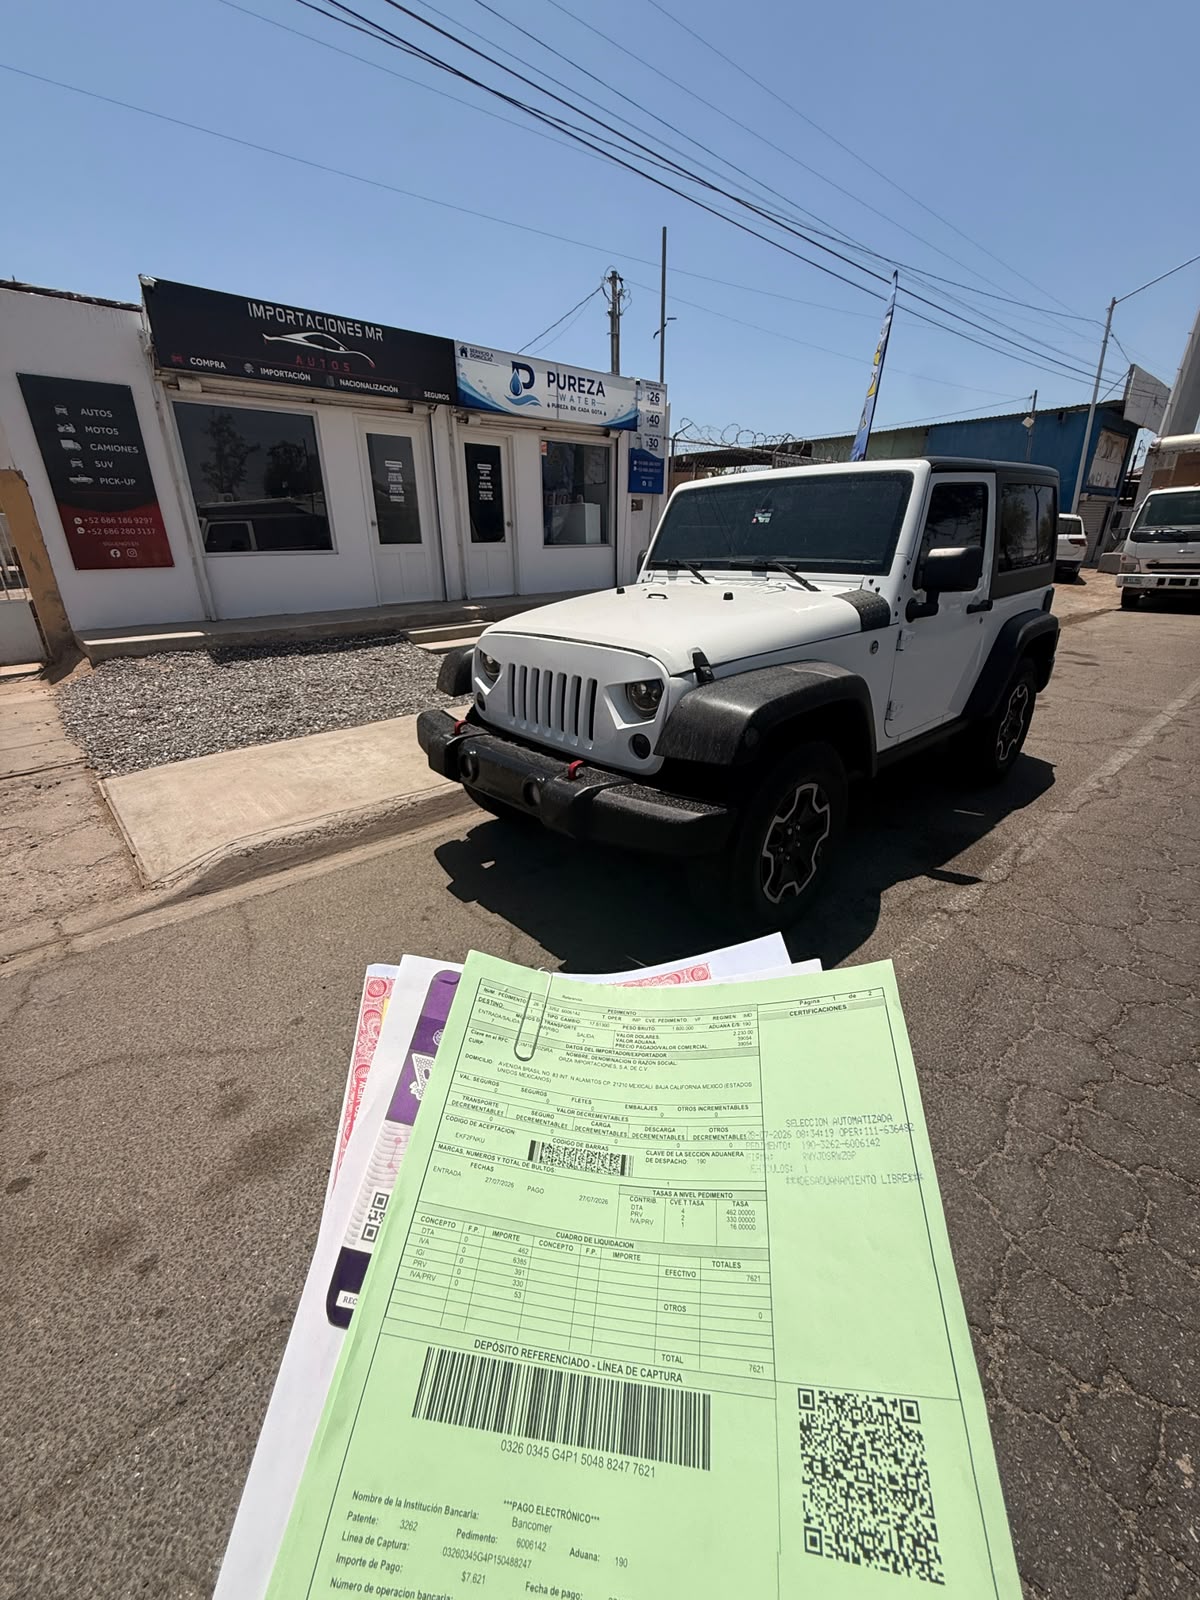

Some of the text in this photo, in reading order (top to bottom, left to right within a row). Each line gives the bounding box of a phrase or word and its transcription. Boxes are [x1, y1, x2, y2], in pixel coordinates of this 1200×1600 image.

[247, 301, 383, 341] IMPORTACIONES MR
[190, 357, 226, 369] COMPRA
[295, 355, 351, 372] AUTOS
[260, 368, 311, 381] IMPORTACIÓN
[340, 379, 399, 393] NACIONALIZACIÓN
[546, 371, 606, 397] PUREZA
[424, 391, 450, 400] SEGUROS
[559, 393, 596, 406] WATER
[647, 392, 660, 402] $26
[81, 409, 112, 417] AUTOS
[647, 415, 660, 425] $40
[85, 426, 119, 435] MOTOS
[90, 444, 139, 453] CAMIONES
[646, 439, 659, 448] $30
[100, 477, 136, 485] PICK-UP
[790, 1004, 847, 1016] CERTIFICACIONES
[465, 1053, 492, 1064] DOMICILIO
[498, 1062, 522, 1071] AVENIDA
[473, 1076, 499, 1086] SEGUROS
[521, 1088, 548, 1096] SEGUROS
[462, 1095, 499, 1108] TRANSPORTE
[531, 1111, 554, 1119] SEGURO
[786, 1114, 893, 1127] SELECCION AUTOMATIZADA
[796, 1128, 834, 1138] 08:34:19
[802, 1138, 880, 1149] 190-3262-6006142
[466, 1150, 520, 1167] NUMEROS TOTAL
[433, 1166, 462, 1177] ENTRADA
[470, 1162, 494, 1172] FECHAS
[485, 1177, 515, 1188] 27/07/2026
[527, 1185, 545, 1194] PAGO
[579, 1194, 609, 1206] 27/07/2026
[421, 1216, 456, 1228] CONCEPTO
[630, 1217, 654, 1225] IVA/PRV
[419, 1237, 429, 1245] IVA
[492, 1231, 520, 1241] IMPORTE
[556, 1232, 634, 1249] CUADRO LIQUIDACION
[539, 1240, 574, 1251] CONCEPTO
[585, 1247, 597, 1255] F.P.
[612, 1252, 641, 1262] IMPORTE
[712, 1261, 741, 1269] TOTALES
[409, 1271, 436, 1281] IVA/PRV
[413, 1259, 523, 1287] PRV 330
[665, 1269, 696, 1278] EFECTIVO
[664, 1304, 687, 1313] OTROS
[474, 1339, 683, 1383] DEPÓSITO REFERENCIADO LÍNEA DE CAPTURA
[662, 1354, 764, 1374] TOTAL 7621
[500, 1439, 655, 1478] 0326 0345 G4P1 5048 8247 7621
[352, 1490, 479, 1520] Nombre de la Institución Bancaria:
[347, 1511, 418, 1531] Patente: 3262
[512, 1517, 552, 1533] Bancomer
[365, 1536, 375, 1545] de
[377, 1536, 409, 1550] Captura:
[456, 1528, 547, 1552] Pedimento: 6006142
[443, 1546, 532, 1568] 03260345G4P150488247
[569, 1547, 628, 1568] Aduana: 190
[336, 1553, 404, 1574] Importe de Pago:
[330, 1577, 362, 1592] Número
[364, 1583, 374, 1593] de
[525, 1581, 560, 1597] Fecha de
